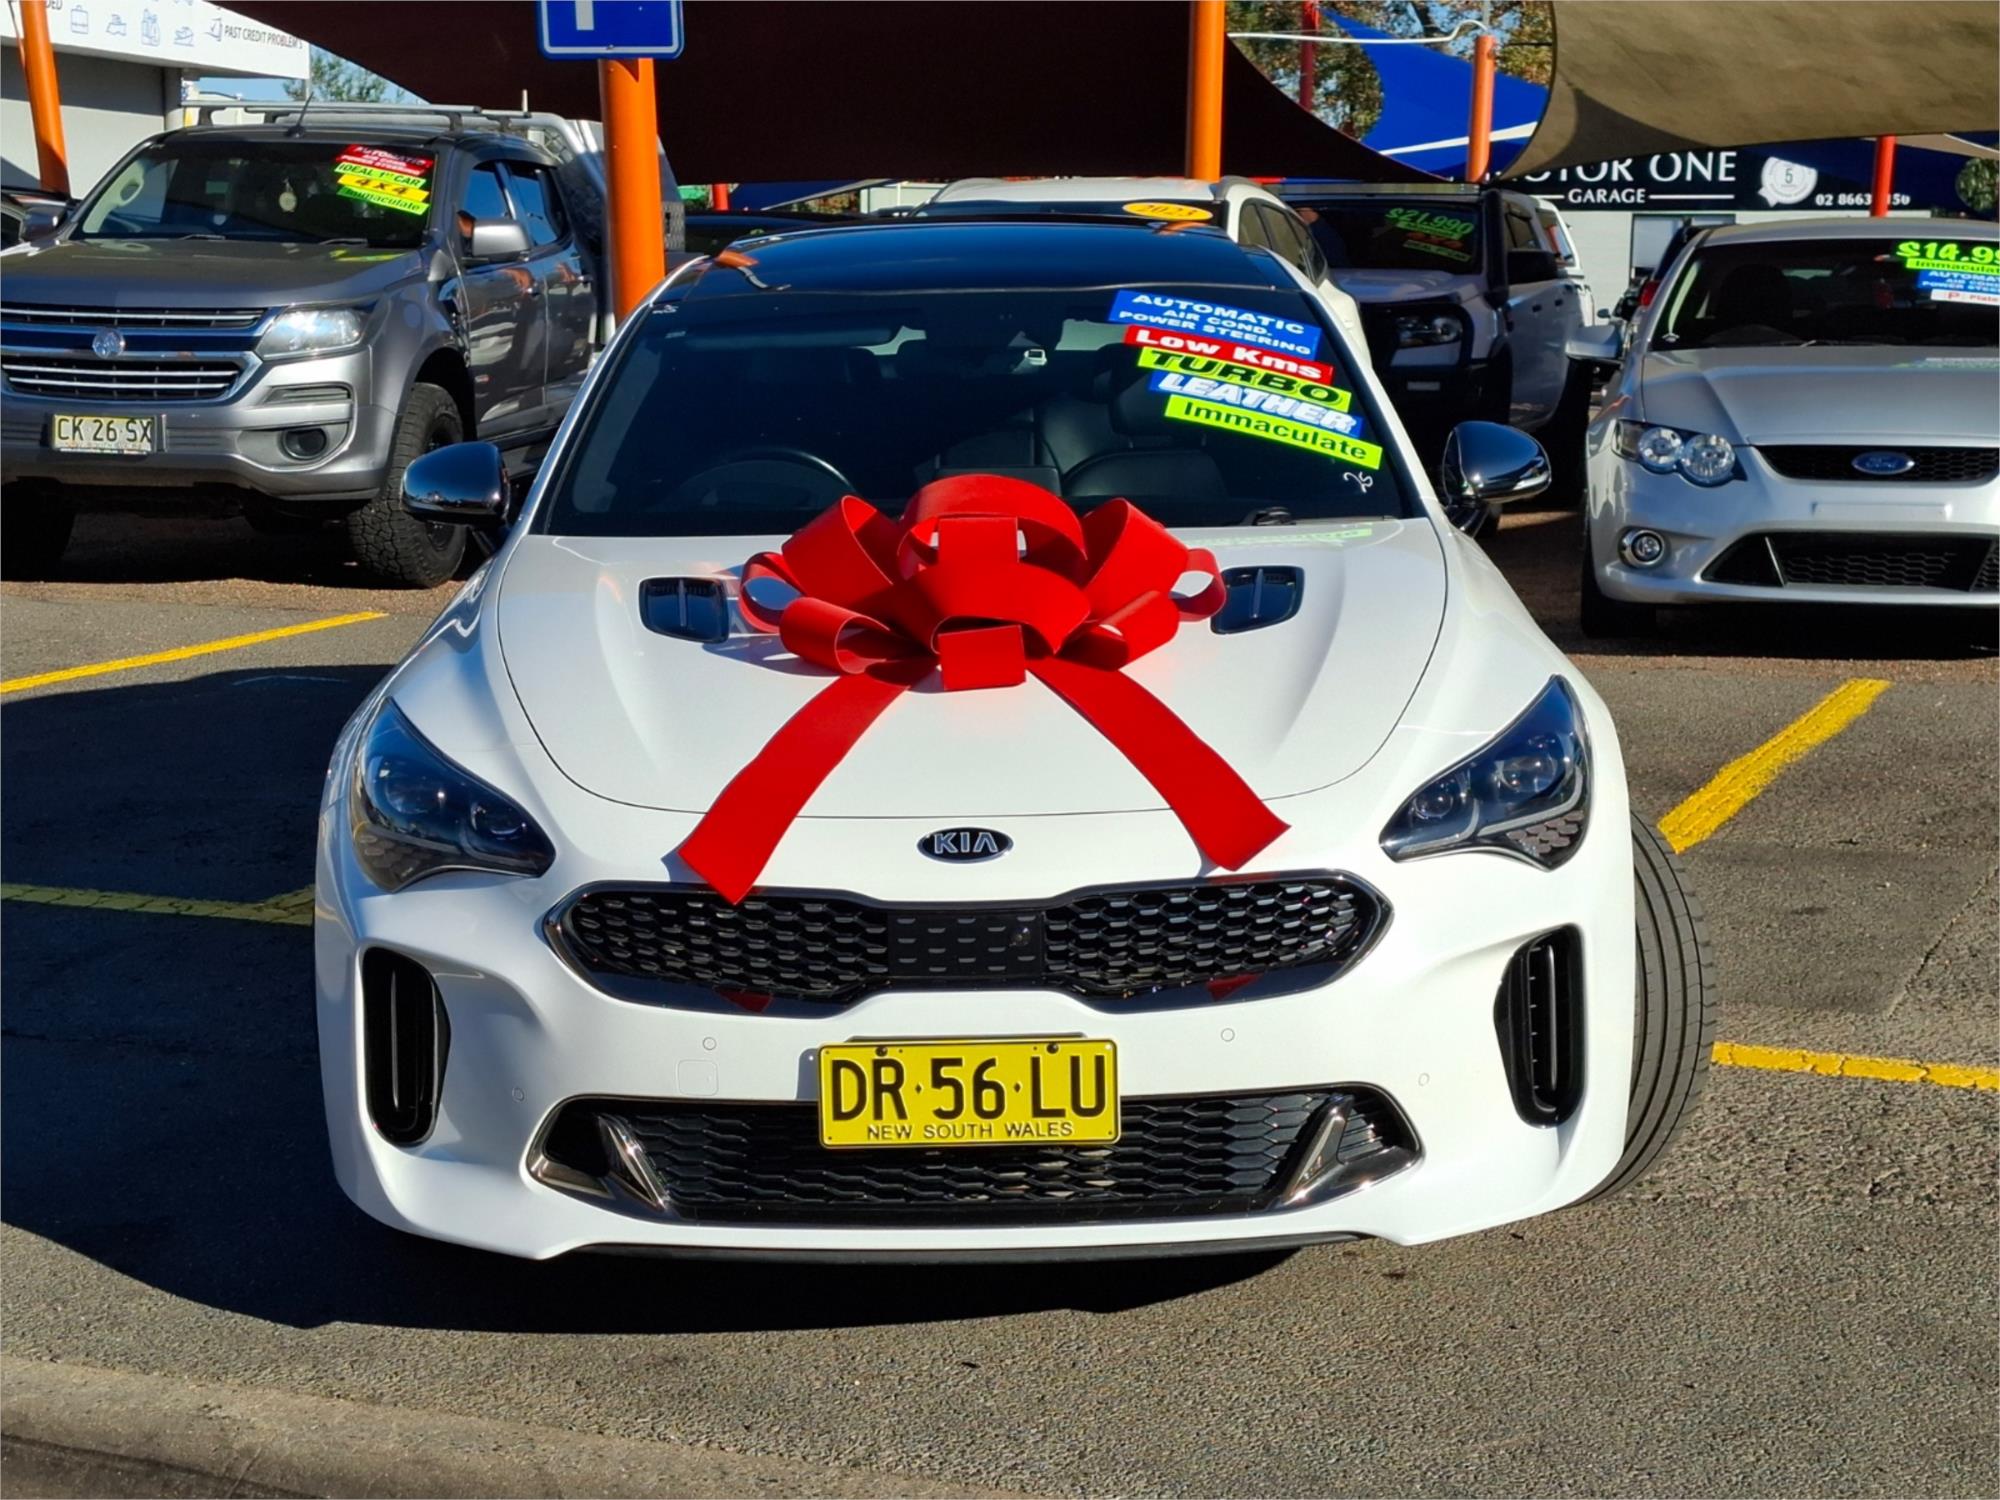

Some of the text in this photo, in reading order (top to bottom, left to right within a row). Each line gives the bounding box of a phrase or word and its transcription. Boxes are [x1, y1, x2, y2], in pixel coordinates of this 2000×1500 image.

[224, 25, 242, 39] PAST
[242, 28, 267, 43] CREDIT
[339, 163, 373, 177] IDEAL
[394, 175, 421, 187] CAR
[1649, 151, 1738, 182] ONE
[355, 178, 371, 186] 4
[392, 186, 408, 194] 4
[1567, 188, 1646, 204] GARAGE
[1815, 194, 1833, 206] 02
[1837, 193, 1872, 206] 8663
[345, 189, 421, 211] Immaculate
[1132, 294, 1305, 335] AUTOMATIC
[1163, 308, 1272, 337] AIR COND.
[1119, 310, 1312, 357] POWER STEERING
[1232, 346, 1322, 380] Kms
[1150, 350, 1342, 407] TURBO
[1157, 373, 1357, 437] LEATHER
[57, 417, 153, 443] CK 26 SX
[1184, 402, 1367, 461] Immaculate
[933, 831, 999, 855] KIA
[831, 1054, 1106, 1121] DR 56 LU
[866, 1120, 1074, 1141] NEW SOUTH WALES
